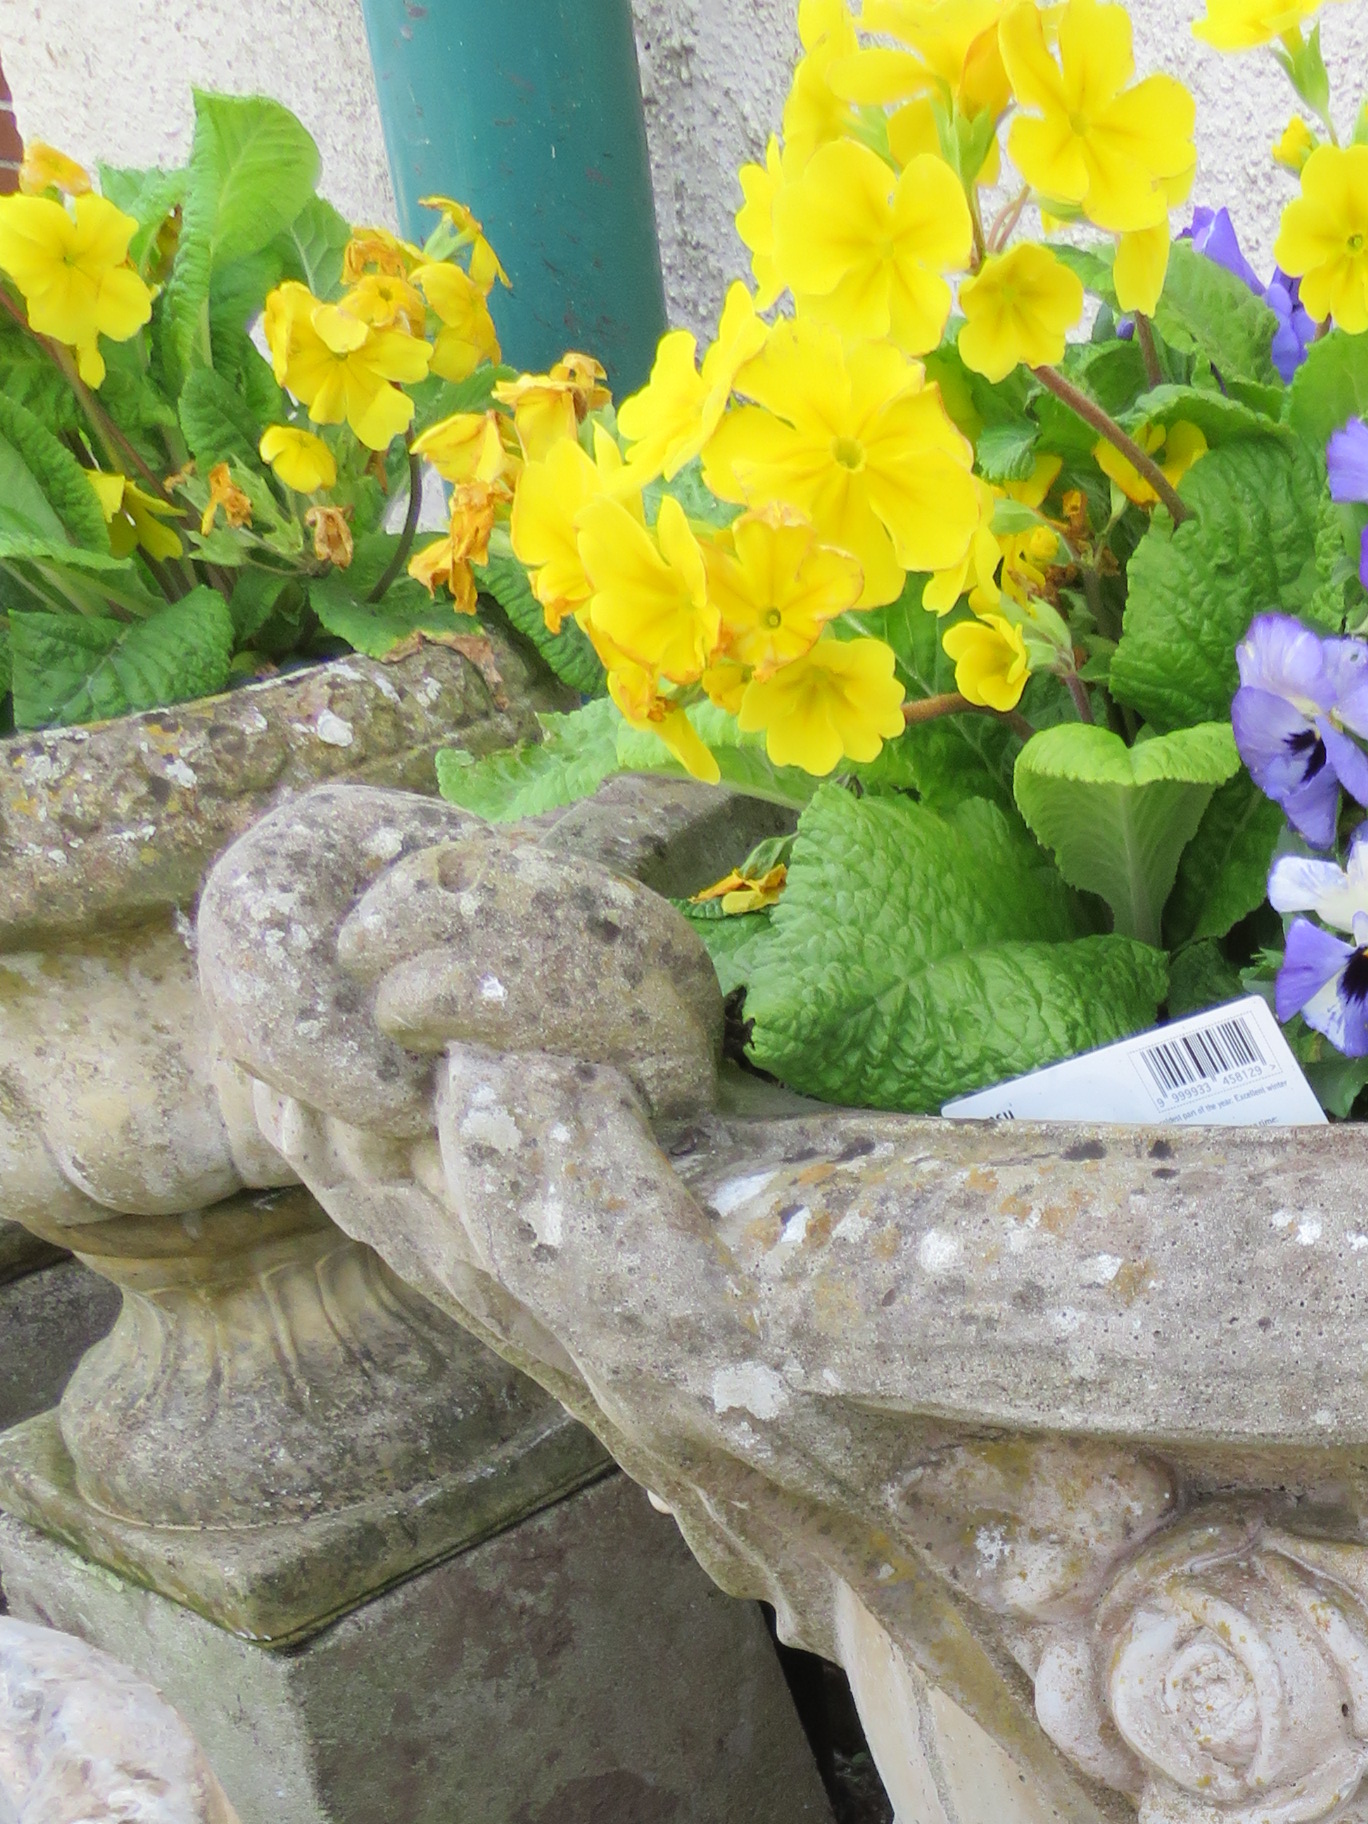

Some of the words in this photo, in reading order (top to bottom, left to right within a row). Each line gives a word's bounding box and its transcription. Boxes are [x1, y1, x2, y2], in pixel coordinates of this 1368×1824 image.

[1157, 1097, 1165, 1108] 9
[1171, 1082, 1212, 1103] 999933
[1222, 1065, 1263, 1086] 458129
[1182, 1109, 1198, 1121] part
[1197, 1105, 1206, 1114] of
[1205, 1101, 1217, 1111] the
[1233, 1087, 1266, 1102] Excellent
[1266, 1080, 1288, 1091] winter
